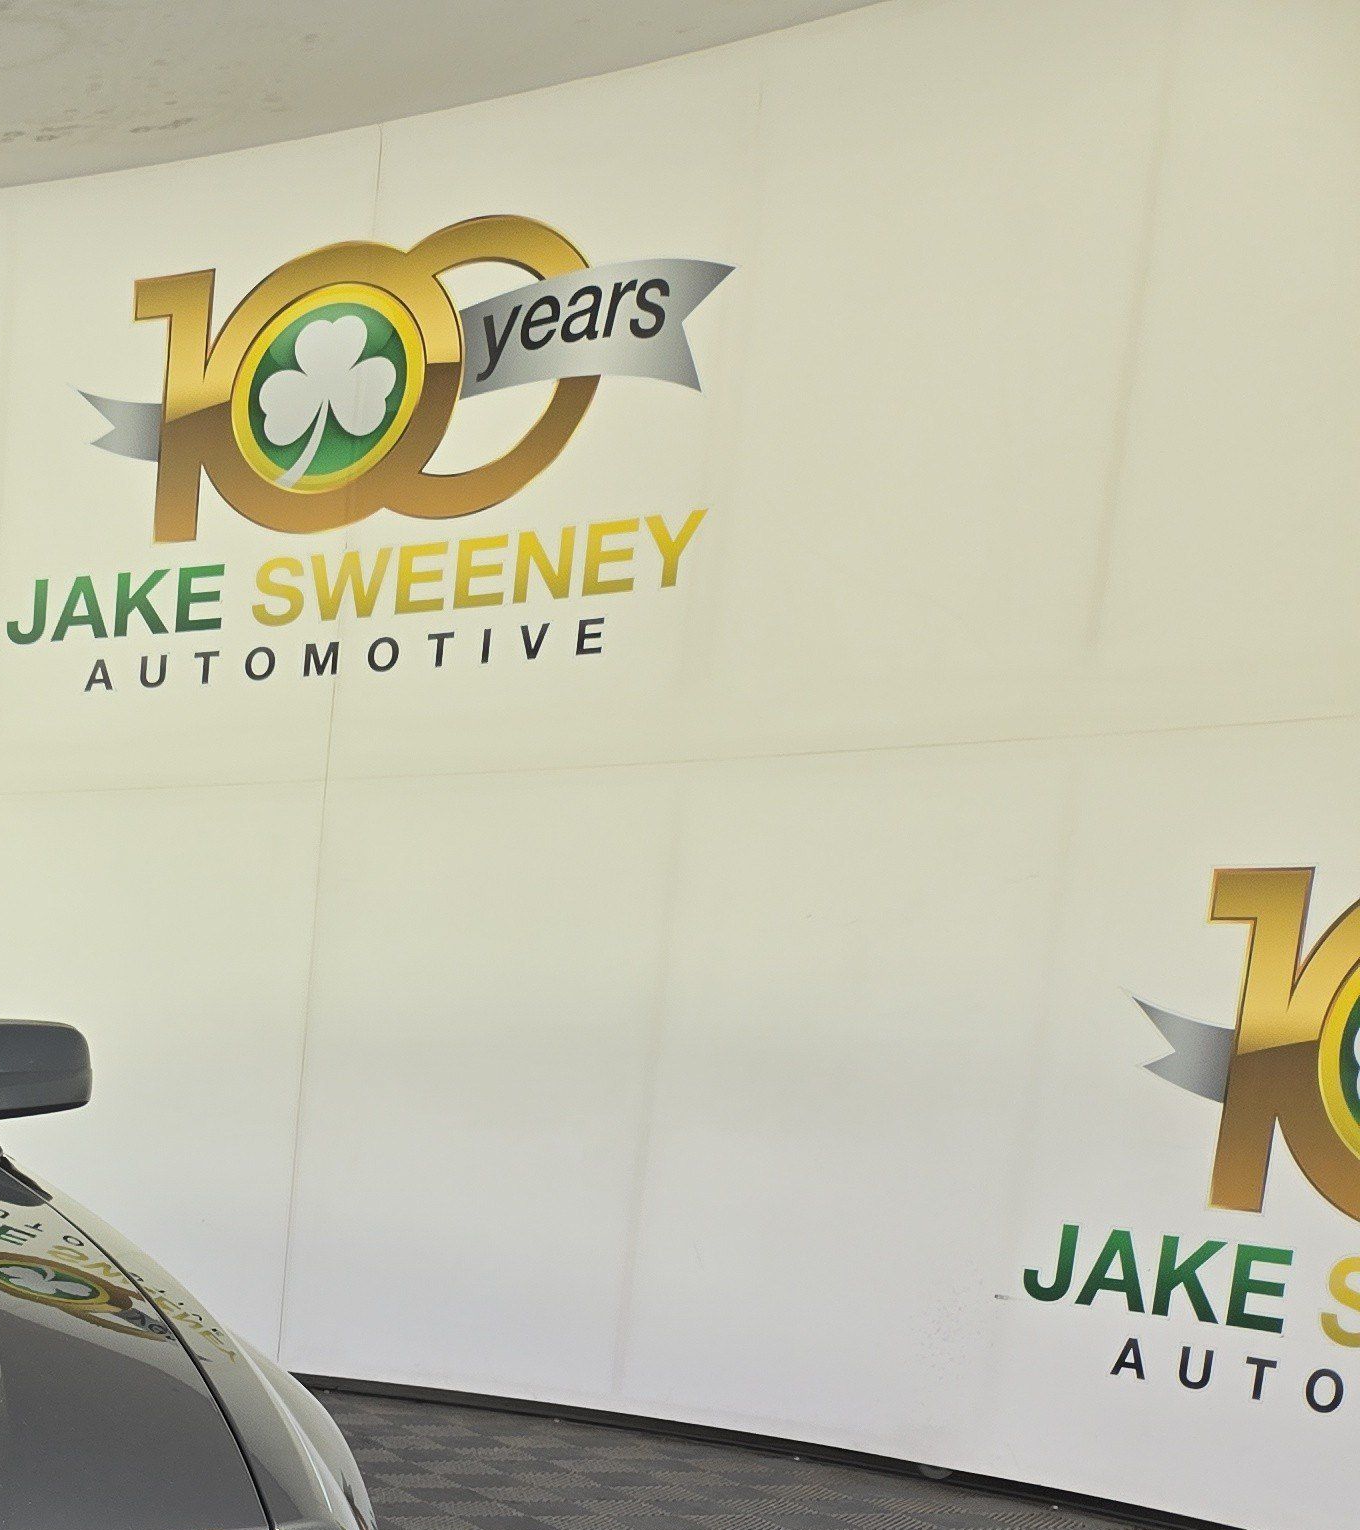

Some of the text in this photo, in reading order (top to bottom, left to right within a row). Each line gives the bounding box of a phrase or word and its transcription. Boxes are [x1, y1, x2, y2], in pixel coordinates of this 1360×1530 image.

[133, 213, 671, 544] 100 years
[5, 507, 710, 646] JAKE SWEENEY
[83, 617, 606, 693] AUTOMOTIVE
[1022, 1223, 1295, 1335] JAKE
[1109, 1336, 1345, 1414] AUTO
